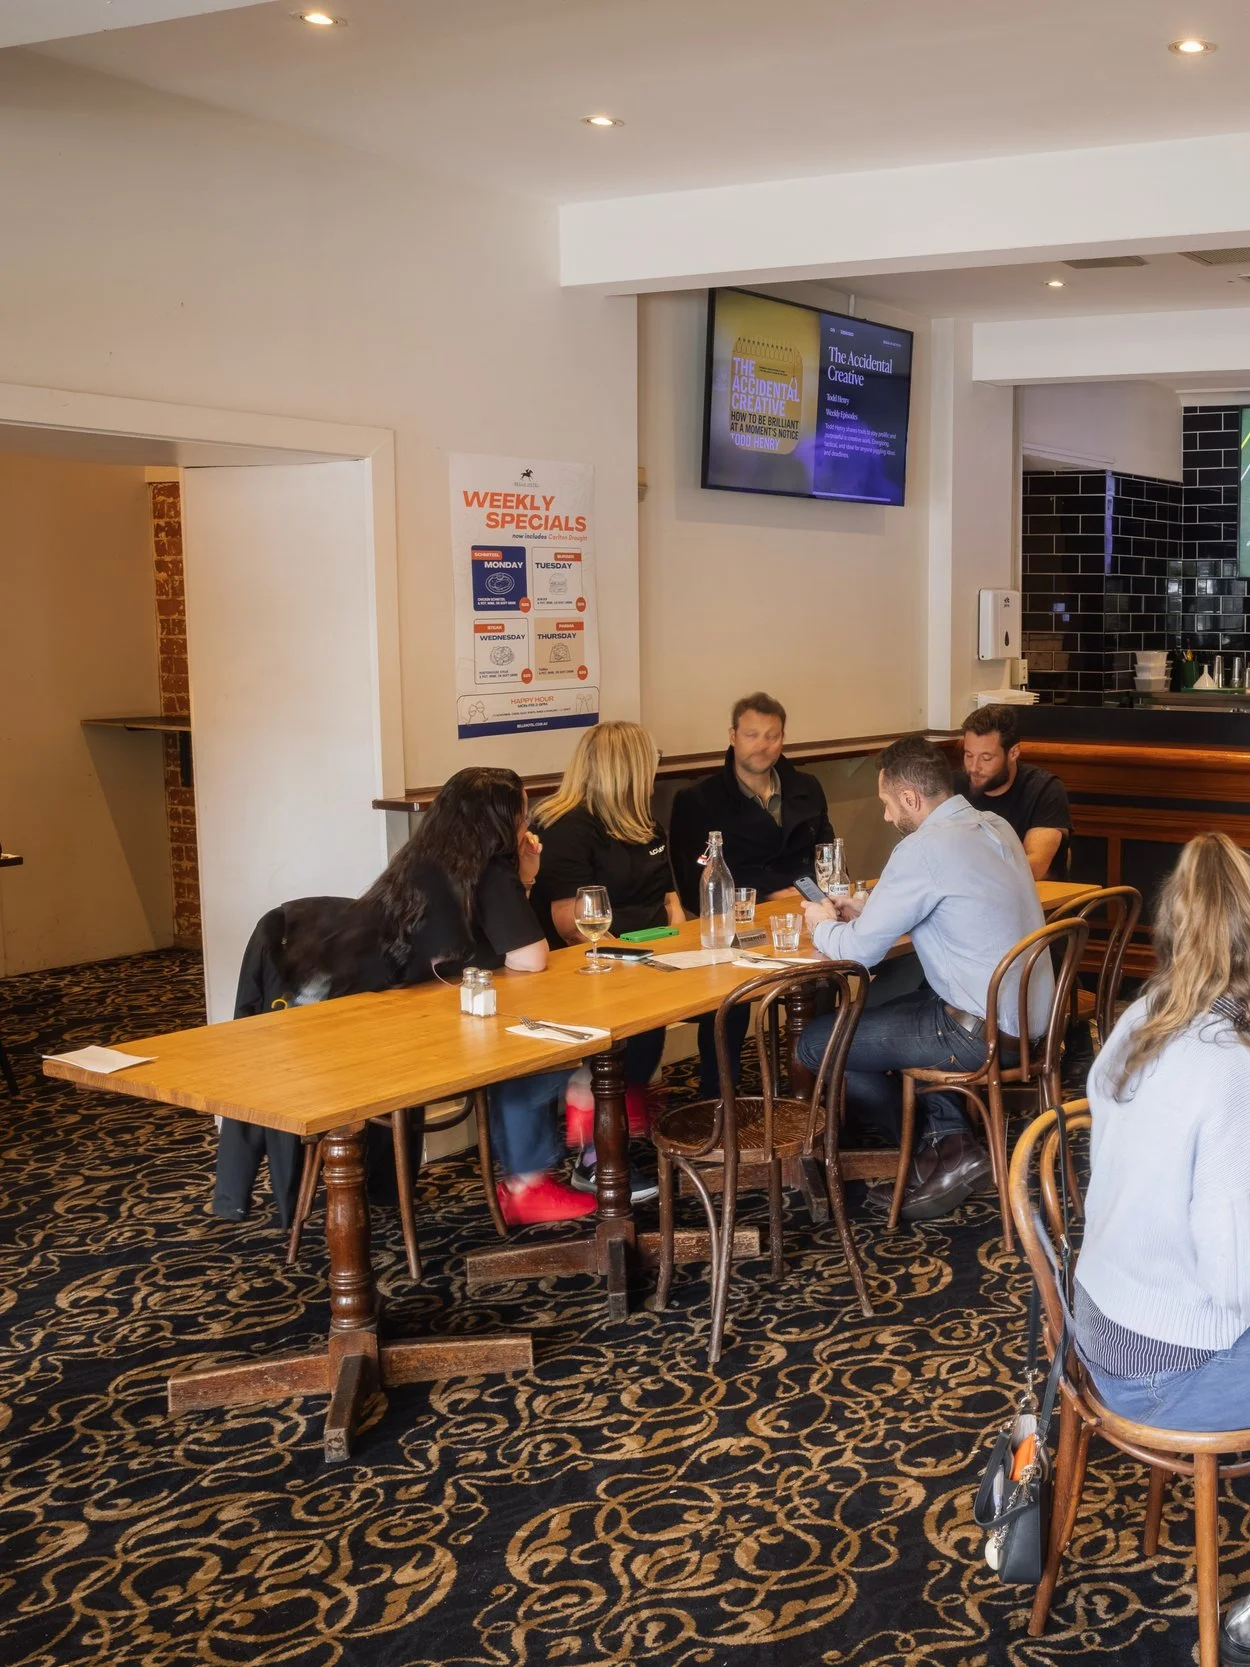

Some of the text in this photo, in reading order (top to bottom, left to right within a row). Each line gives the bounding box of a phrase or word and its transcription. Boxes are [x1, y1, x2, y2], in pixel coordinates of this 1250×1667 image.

[733, 357, 756, 377] THE
[829, 346, 893, 374] The Accidental
[828, 365, 865, 386] Creative
[732, 376, 800, 402] ACCIDENTAL
[731, 393, 786, 417] CREATIVE
[730, 421, 800, 440] AT A MOMENT'S NOTICE
[731, 411, 800, 430] HOW TO BE BRILLIANT
[730, 432, 780, 450] TODD HENRY
[463, 490, 555, 511] WEEKLY
[485, 511, 587, 532] SPECIALS
[484, 561, 523, 569] MONDAY
[510, 695, 554, 705] HAPPY HOUR
